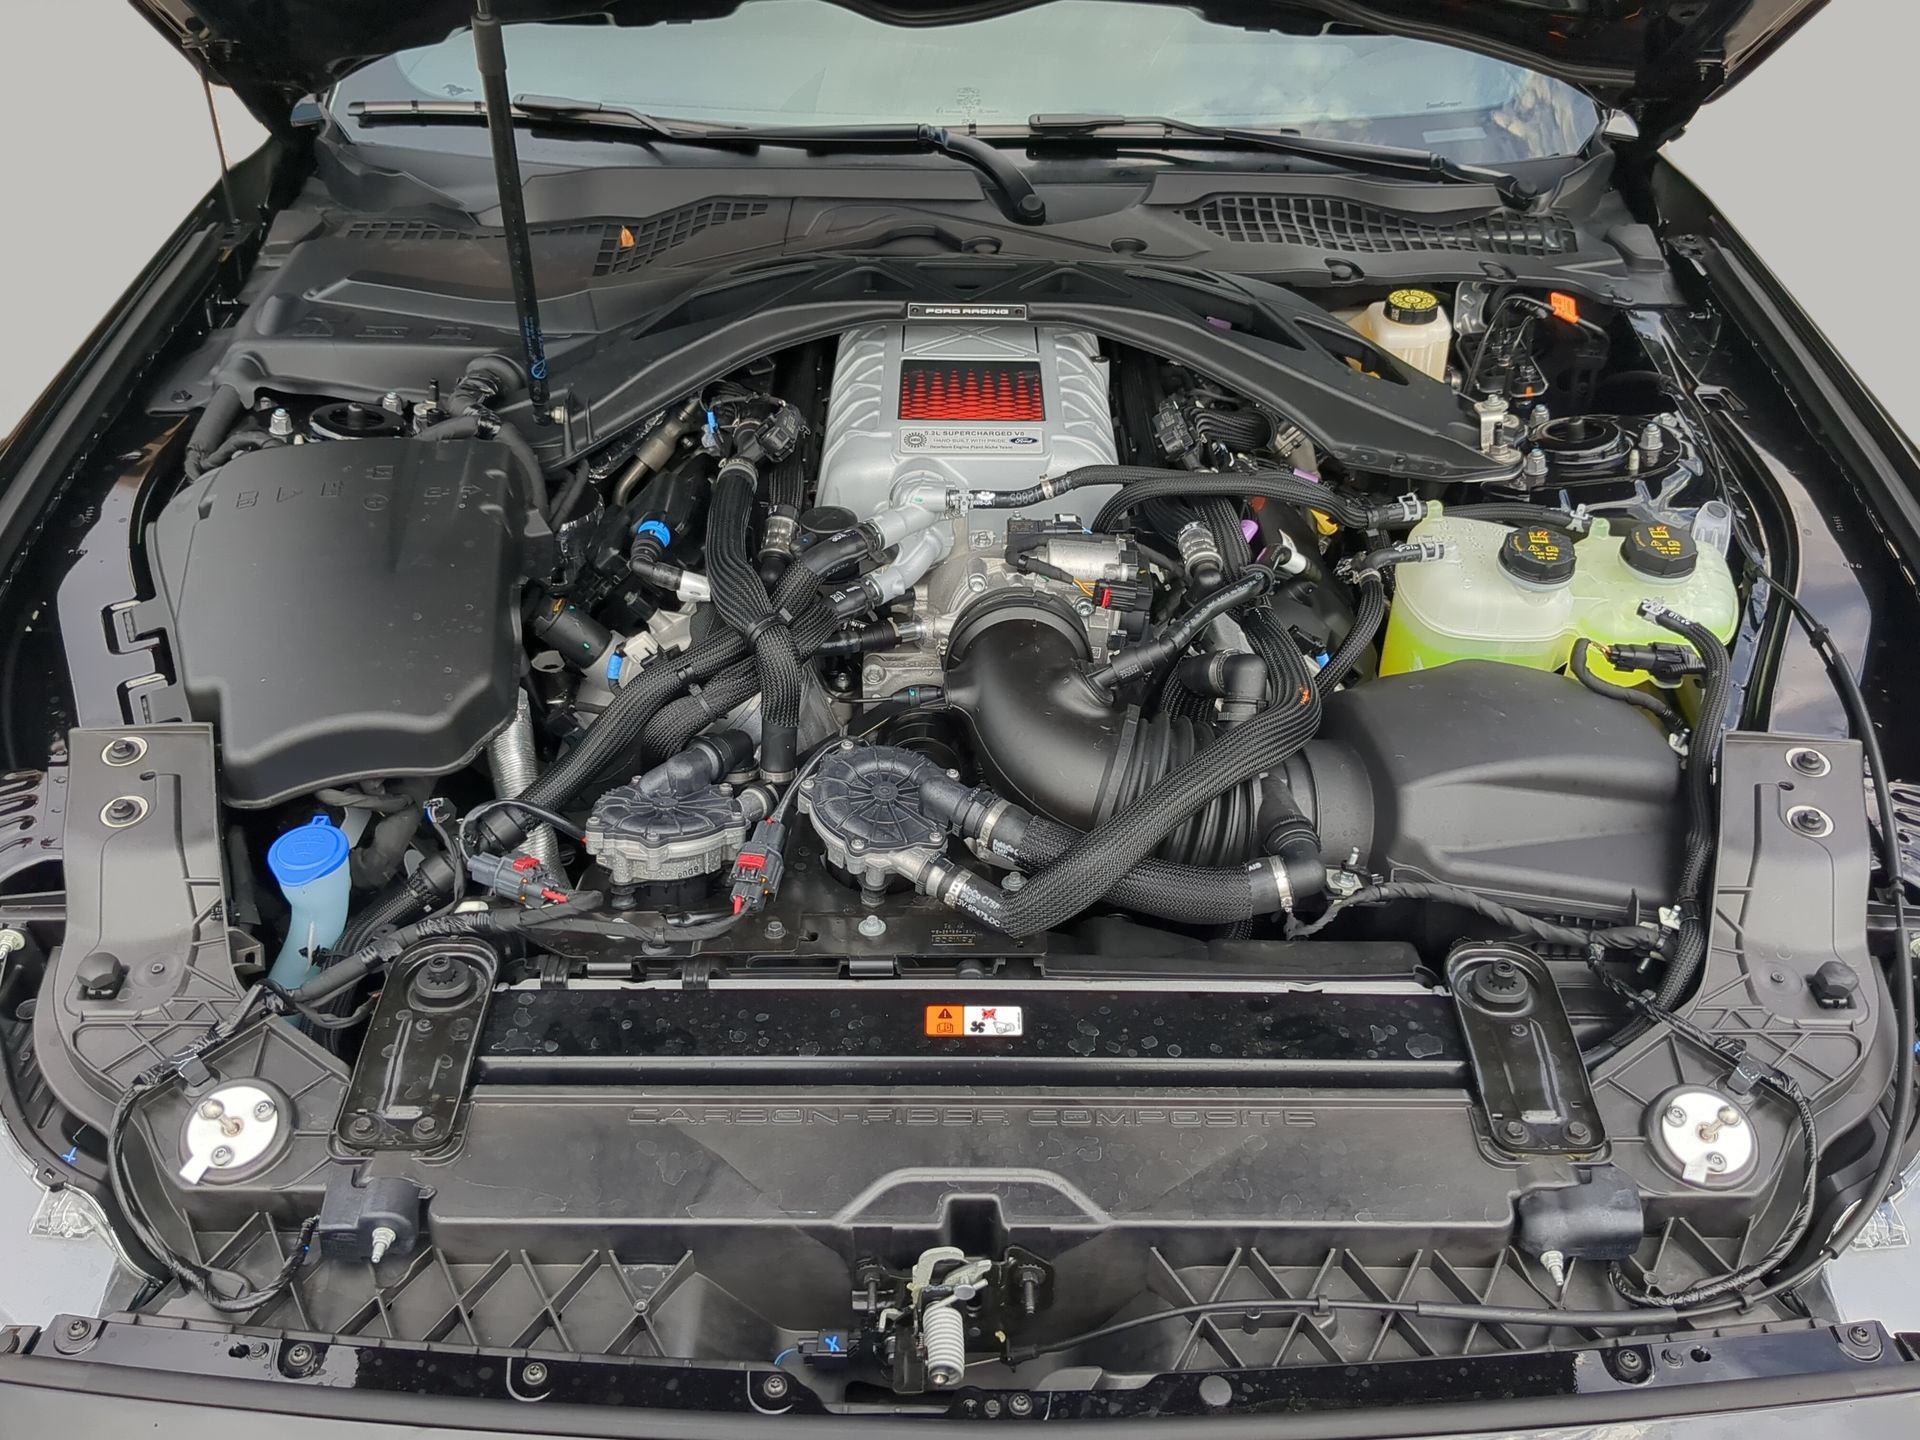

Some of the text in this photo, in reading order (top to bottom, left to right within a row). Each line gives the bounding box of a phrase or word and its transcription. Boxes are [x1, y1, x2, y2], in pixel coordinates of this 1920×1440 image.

[925, 307, 1009, 315] FORD RACING
[962, 884, 982, 900] MoCo
[627, 1106, 1318, 1128] CARBON-FIBER COMPOSITE
